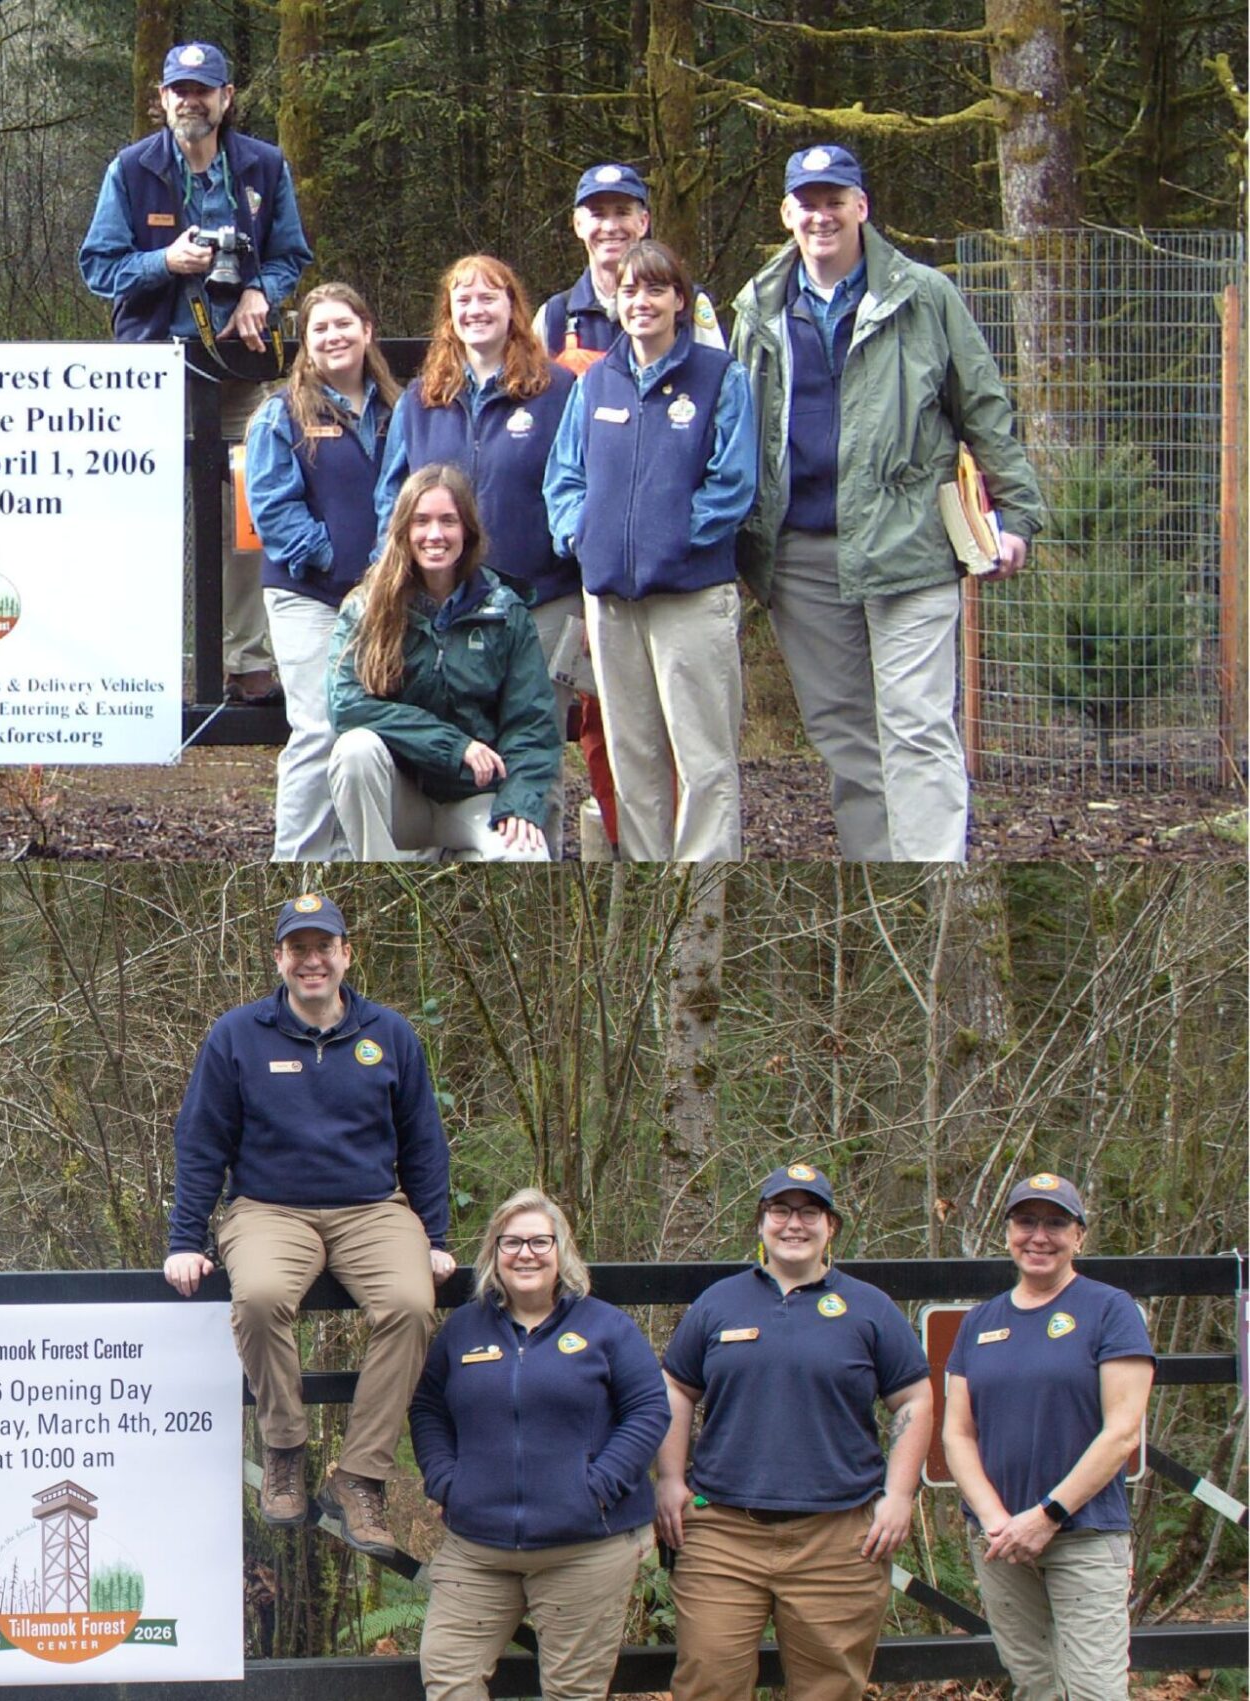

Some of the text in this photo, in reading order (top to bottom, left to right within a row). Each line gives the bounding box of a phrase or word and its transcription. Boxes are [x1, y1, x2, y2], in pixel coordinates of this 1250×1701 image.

[62, 363, 168, 390] Center
[26, 407, 121, 433] Public
[51, 450, 74, 478] 1,
[85, 449, 156, 475] 2006
[7, 679, 21, 693] &
[27, 678, 92, 696] Delivery
[100, 678, 165, 693] Vehicles
[0, 701, 70, 719] Entering
[74, 702, 89, 716] &
[95, 701, 154, 719] Exiting
[41, 1338, 89, 1360] Forest
[93, 1337, 144, 1360] Center
[10, 1379, 102, 1406] Opening
[110, 1378, 153, 1405] Day
[38, 1412, 110, 1435] March
[117, 1411, 157, 1436] 4th,
[164, 1410, 213, 1433] 2026
[21, 1447, 75, 1469] 10:00
[82, 1451, 115, 1468] am
[8, 1616, 126, 1637] Tillamook Forest
[134, 1626, 172, 1641] 2026
[37, 1640, 99, 1651] CENTER
